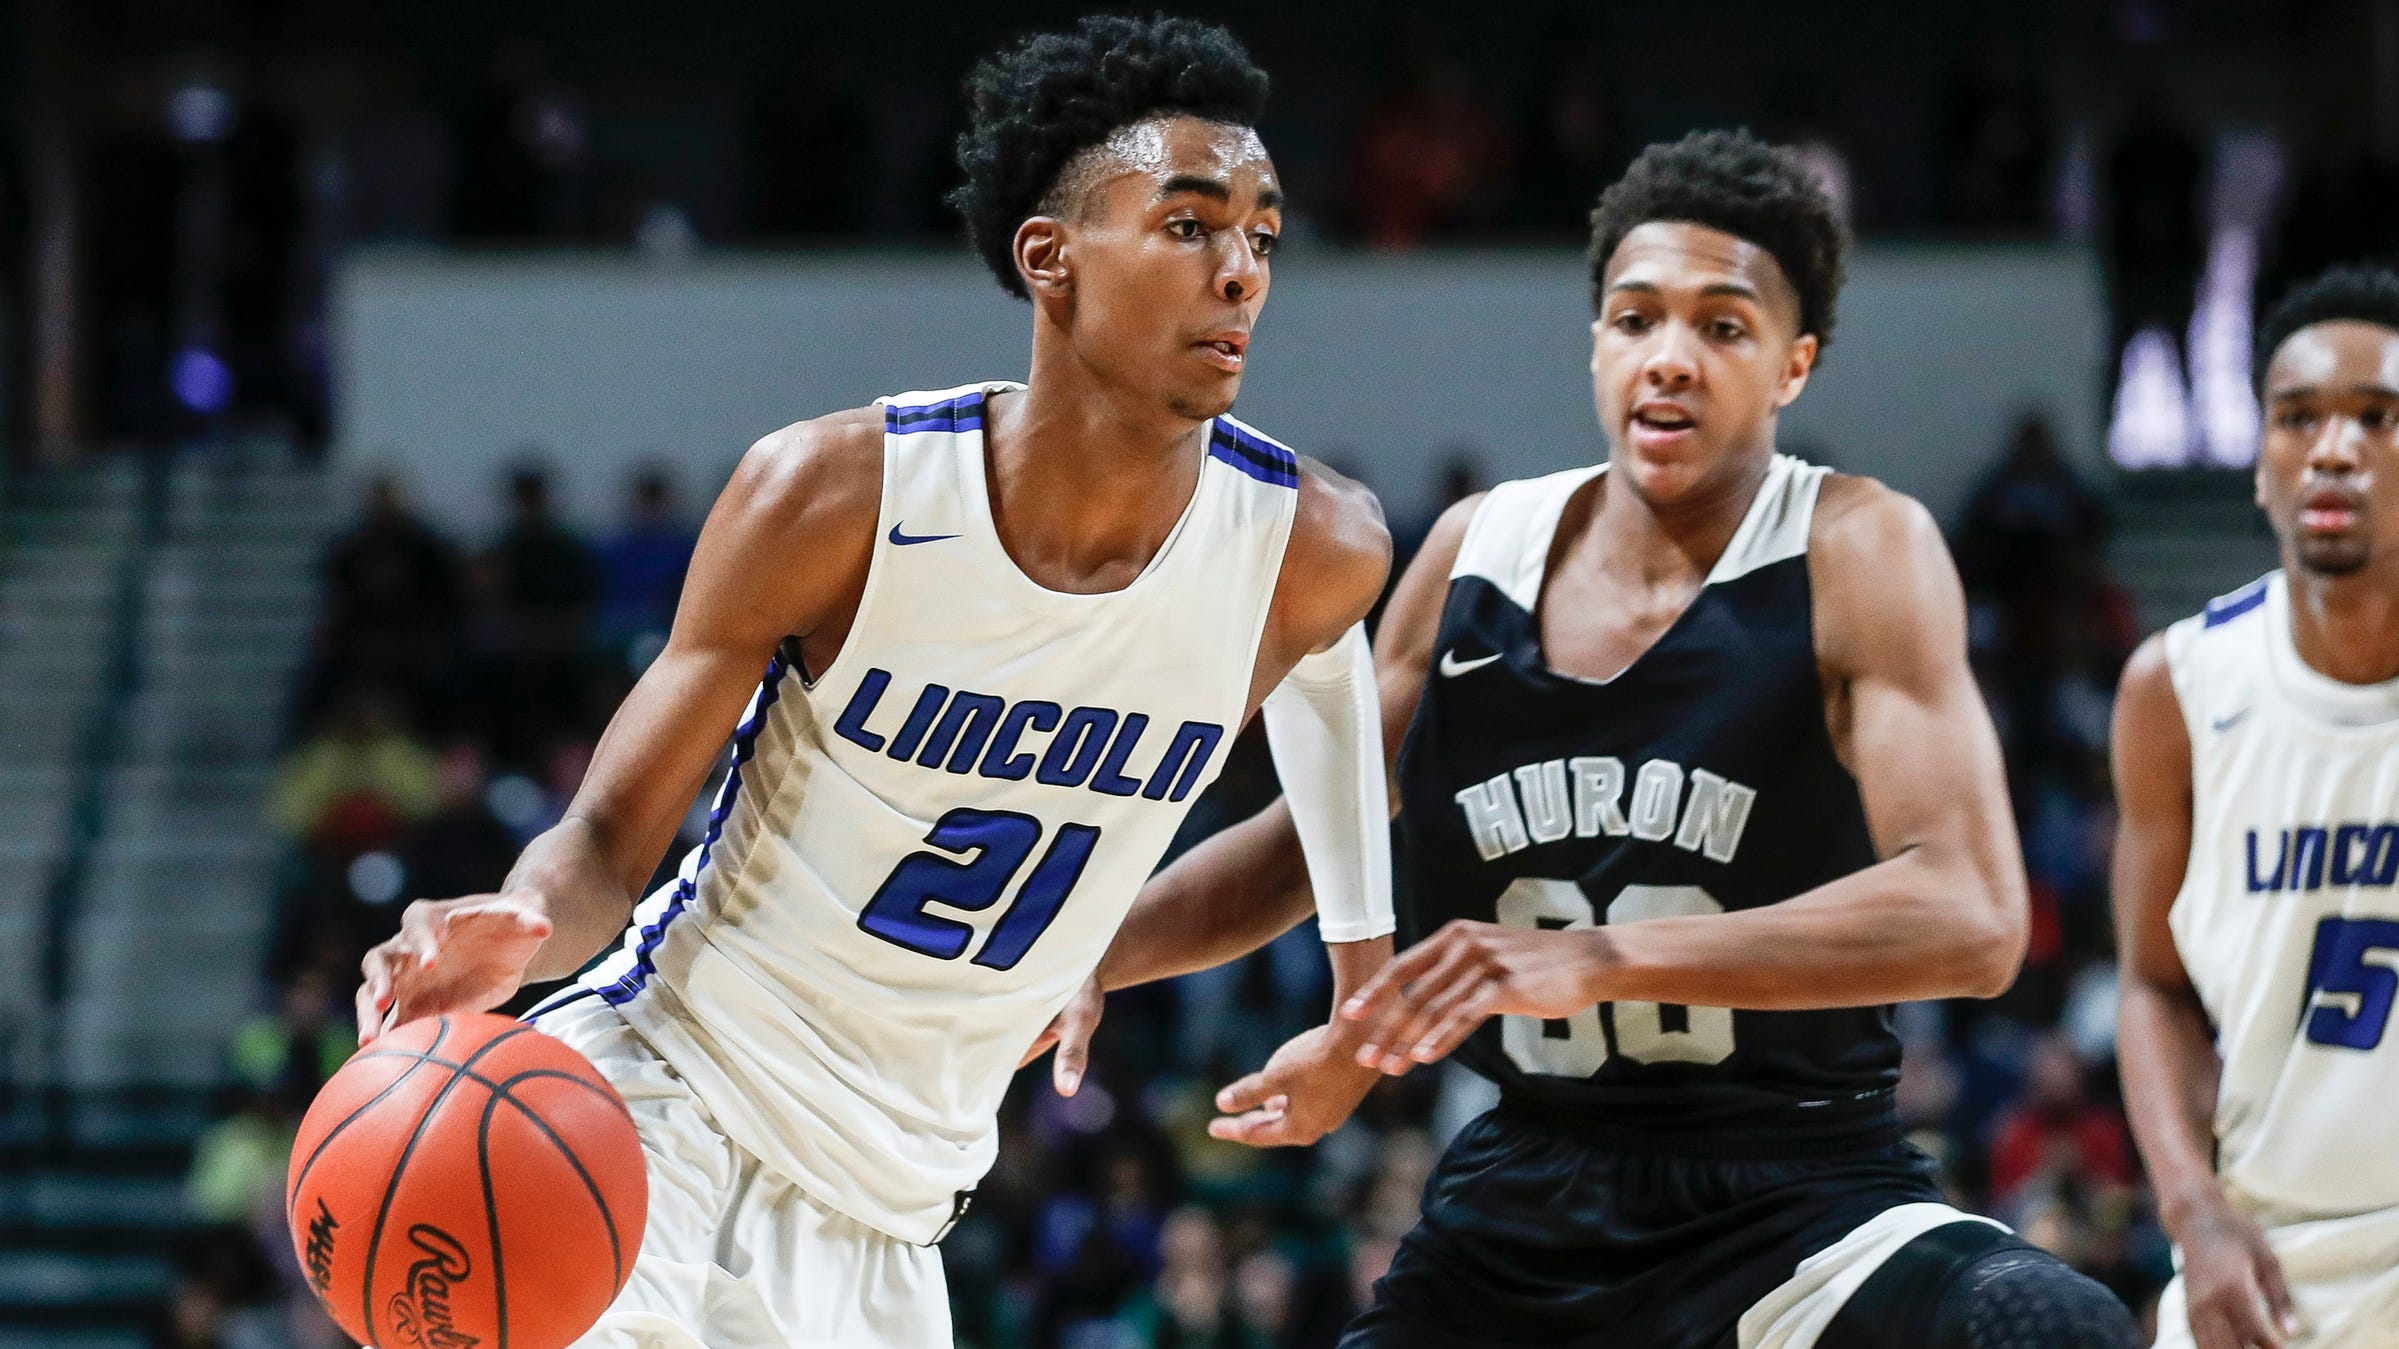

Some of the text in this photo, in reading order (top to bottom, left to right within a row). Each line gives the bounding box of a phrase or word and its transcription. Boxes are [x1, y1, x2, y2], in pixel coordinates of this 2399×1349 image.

[834, 667, 1224, 802] LINCOLN
[1455, 756, 1758, 864] HURON
[2245, 825, 2399, 893] LINCO
[856, 807, 1102, 972] 21
[2304, 916, 2399, 1051] 5
